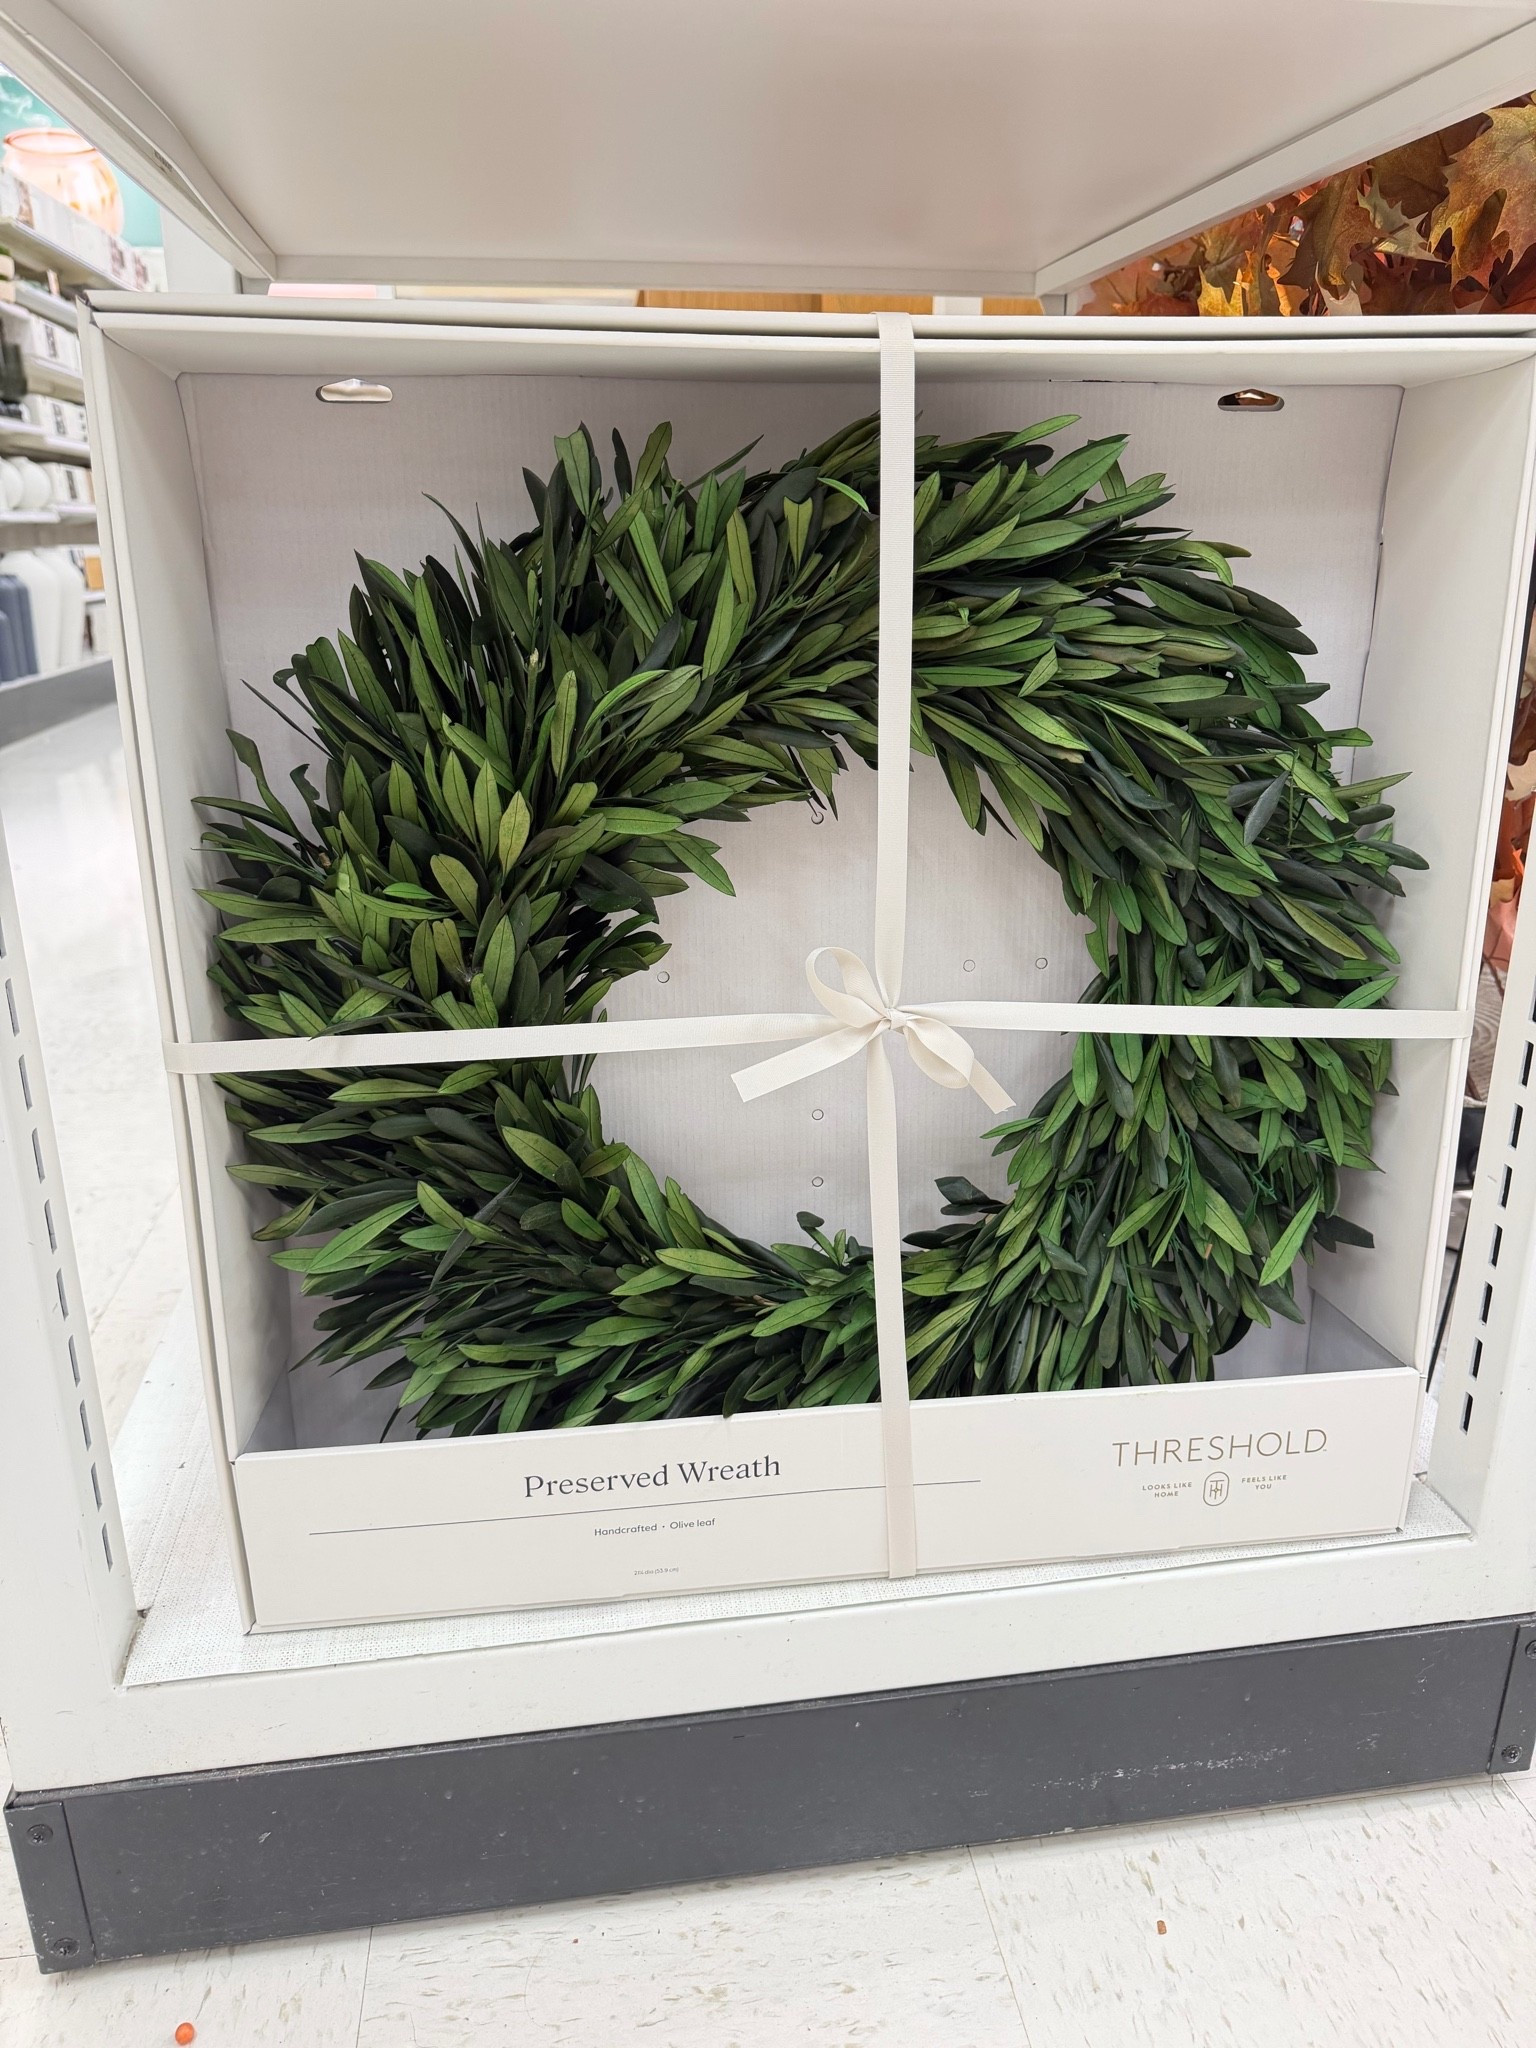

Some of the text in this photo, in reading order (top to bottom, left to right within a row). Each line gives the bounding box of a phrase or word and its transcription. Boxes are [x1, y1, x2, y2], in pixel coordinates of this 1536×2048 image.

[1112, 1429, 1326, 1467] THRESHOLD
[524, 1454, 781, 1498] Preserved Wreath
[1269, 1474, 1287, 1482] LIKE
[1142, 1481, 1193, 1491] LOOKS LIKE
[1154, 1490, 1179, 1498] HOME
[594, 1517, 716, 1537] Handcrafted Olive leaf
